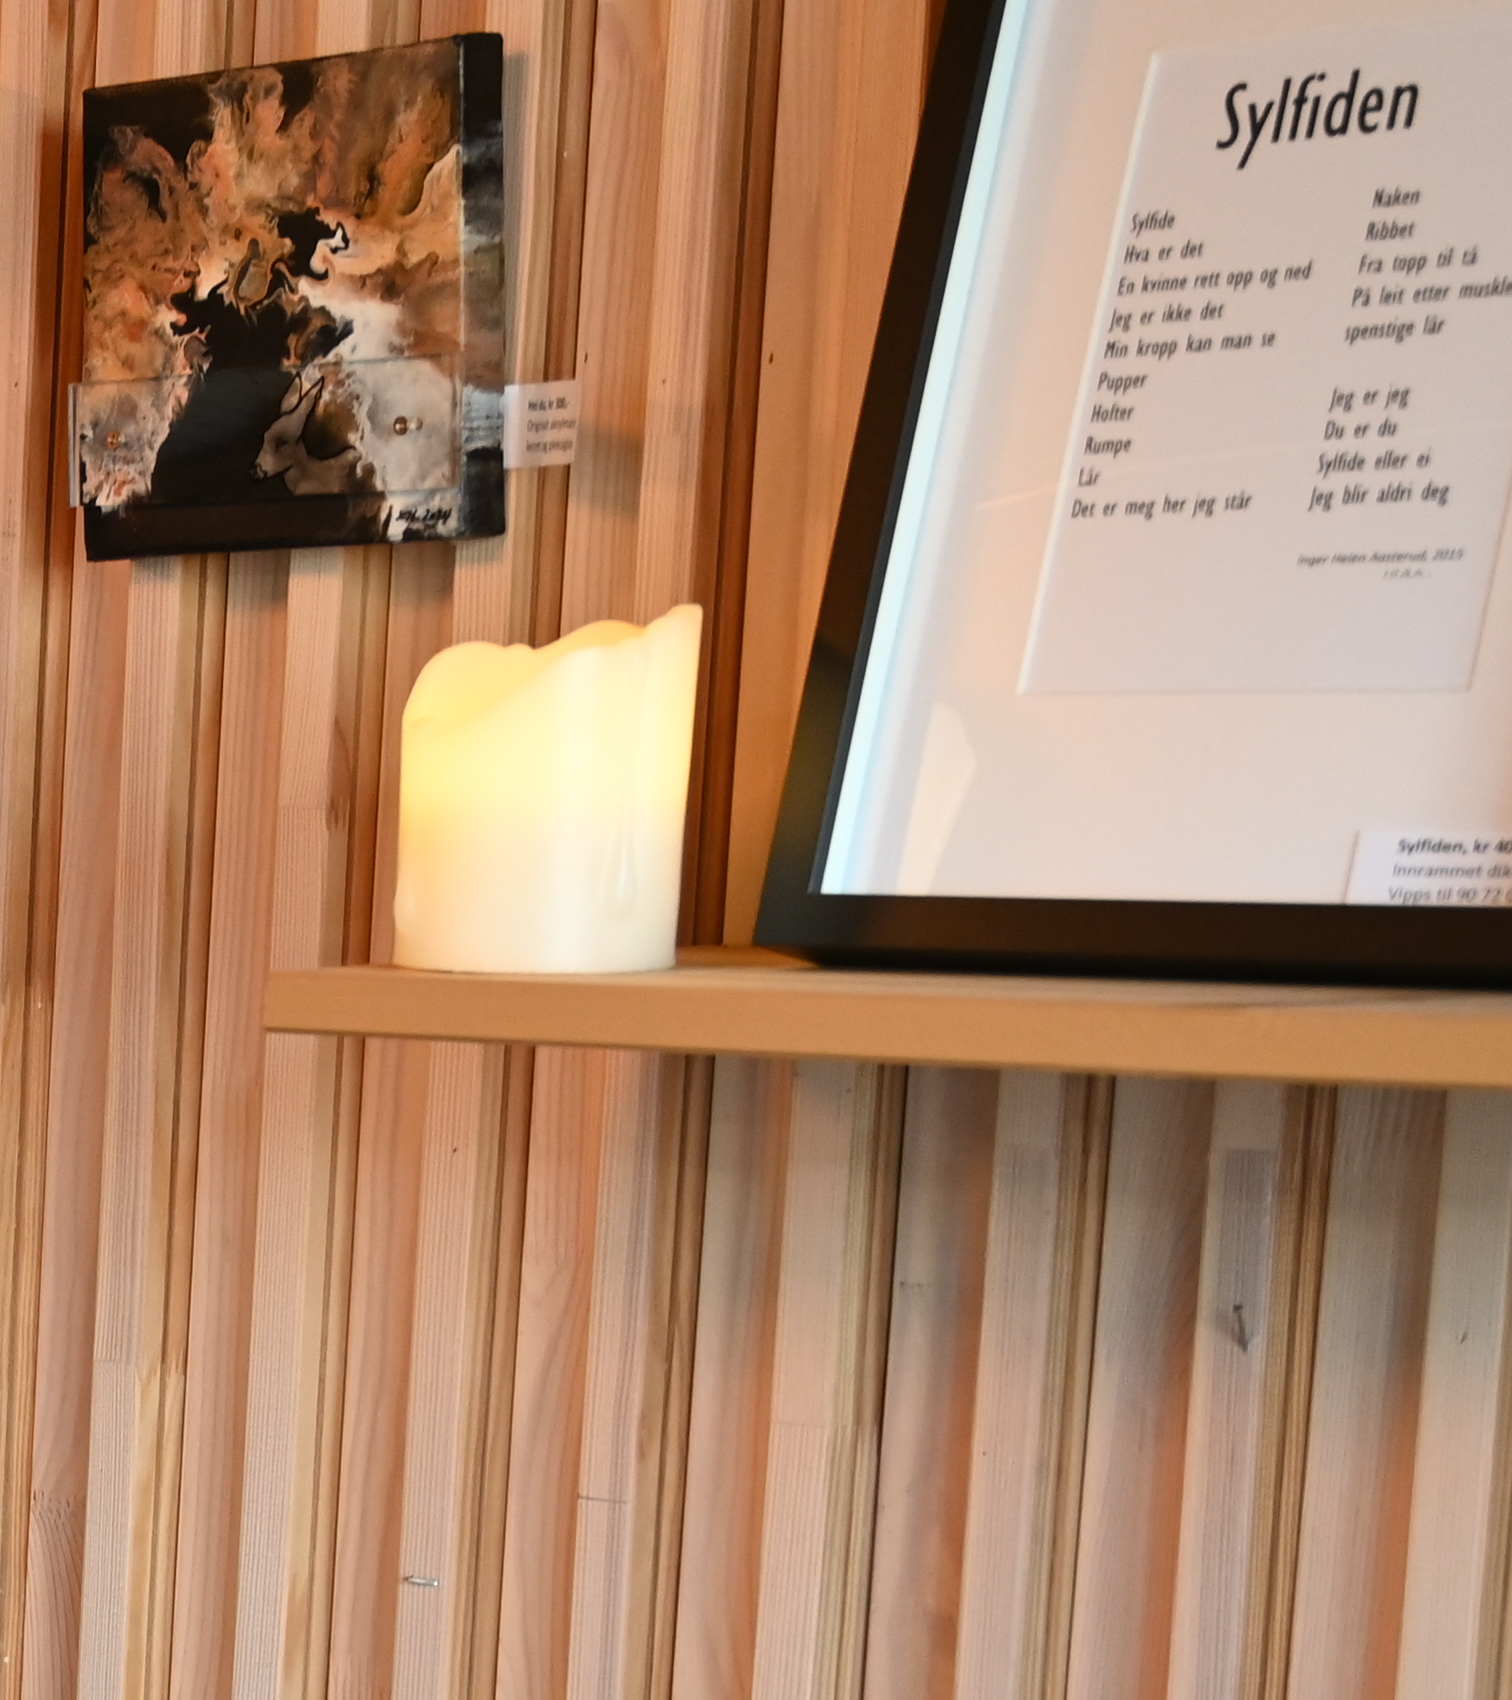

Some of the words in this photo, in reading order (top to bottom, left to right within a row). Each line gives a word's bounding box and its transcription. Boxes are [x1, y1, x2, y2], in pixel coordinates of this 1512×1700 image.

[1215, 66, 1419, 170] Sylfiden
[1371, 186, 1421, 208] Naken
[1131, 210, 1175, 238] Sylfide
[1365, 220, 1415, 241] Ribbet
[1124, 245, 1149, 264] Hva
[1158, 246, 1173, 261] er
[1180, 238, 1204, 259] det
[1358, 253, 1383, 274] Fra
[1392, 253, 1428, 277] topp
[1436, 246, 1455, 269] til
[1461, 244, 1479, 267] tå
[1117, 276, 1135, 296] En
[1141, 275, 1187, 293] kvinne
[1193, 271, 1221, 289] rett
[1226, 269, 1253, 291] opp
[1259, 267, 1278, 288] og
[1284, 258, 1313, 281] ned
[1351, 285, 1371, 308] På
[1378, 284, 1405, 306] leit
[1413, 285, 1450, 304] etter
[1108, 308, 1132, 333] Jeg
[1140, 311, 1154, 325] er
[1161, 302, 1192, 323] ikke
[1200, 299, 1224, 321] det
[1344, 317, 1415, 345] spenstige
[1423, 313, 1445, 335] lår
[1103, 340, 1128, 359] Min
[1136, 338, 1177, 361] kropp
[1185, 333, 1212, 352] kan
[1220, 333, 1253, 350] man
[1261, 332, 1275, 347] se
[1097, 371, 1147, 396] Pupper
[1328, 386, 1354, 413] Jeg
[1363, 389, 1379, 406] er
[1384, 384, 1411, 410] jeg
[1090, 403, 1134, 424] Hofter
[1324, 419, 1345, 441] Du
[1354, 422, 1370, 439] er
[1377, 416, 1397, 438] du
[1084, 436, 1132, 459] Rumpe
[1077, 466, 1100, 487] Lår
[1317, 450, 1365, 479] Sylfide
[1374, 449, 1408, 471] eller
[1416, 446, 1431, 469] ei
[1071, 499, 1096, 518] Det
[1102, 501, 1117, 517] er
[1124, 499, 1156, 520] meg
[1162, 493, 1187, 513] her
[1192, 493, 1217, 518] jeg
[1224, 488, 1252, 511] står
[1307, 485, 1334, 513] Jeg
[1341, 483, 1369, 505] blir
[1376, 481, 1413, 504] aldri
[1421, 479, 1450, 508] deg
[1388, 886, 1430, 905] Vipps
